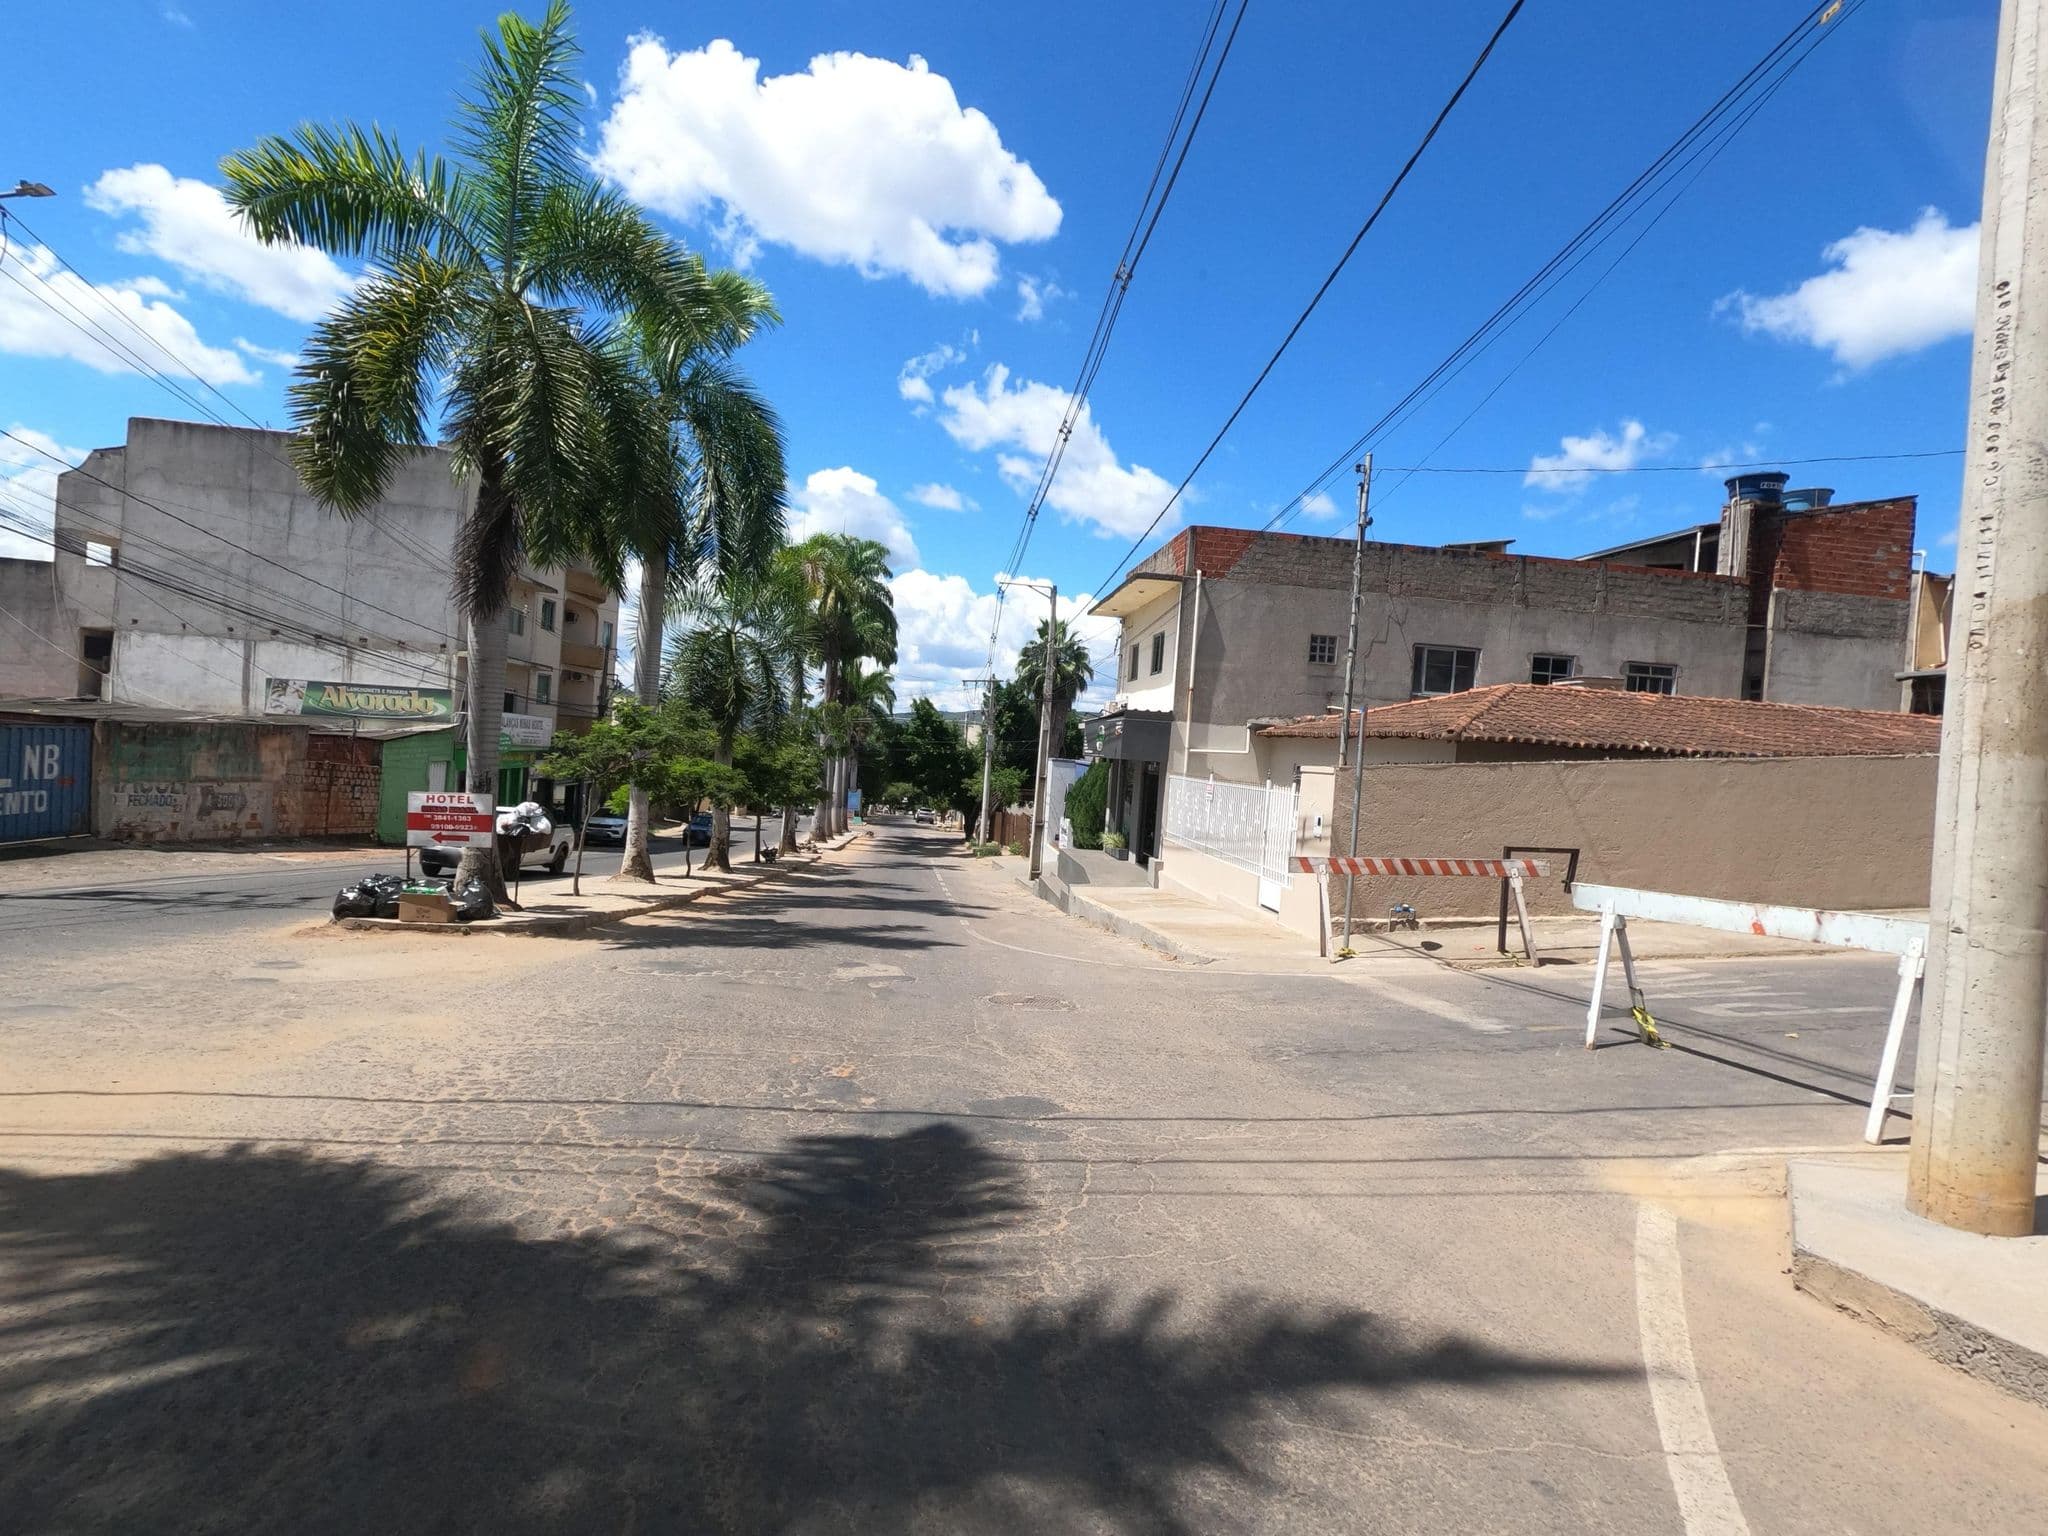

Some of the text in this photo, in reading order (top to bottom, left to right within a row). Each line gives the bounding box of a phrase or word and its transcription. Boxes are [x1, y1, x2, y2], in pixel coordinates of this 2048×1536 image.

[320, 685, 435, 713] Alvorada
[24, 744, 60, 780] NB
[426, 794, 474, 804] HOTEL
